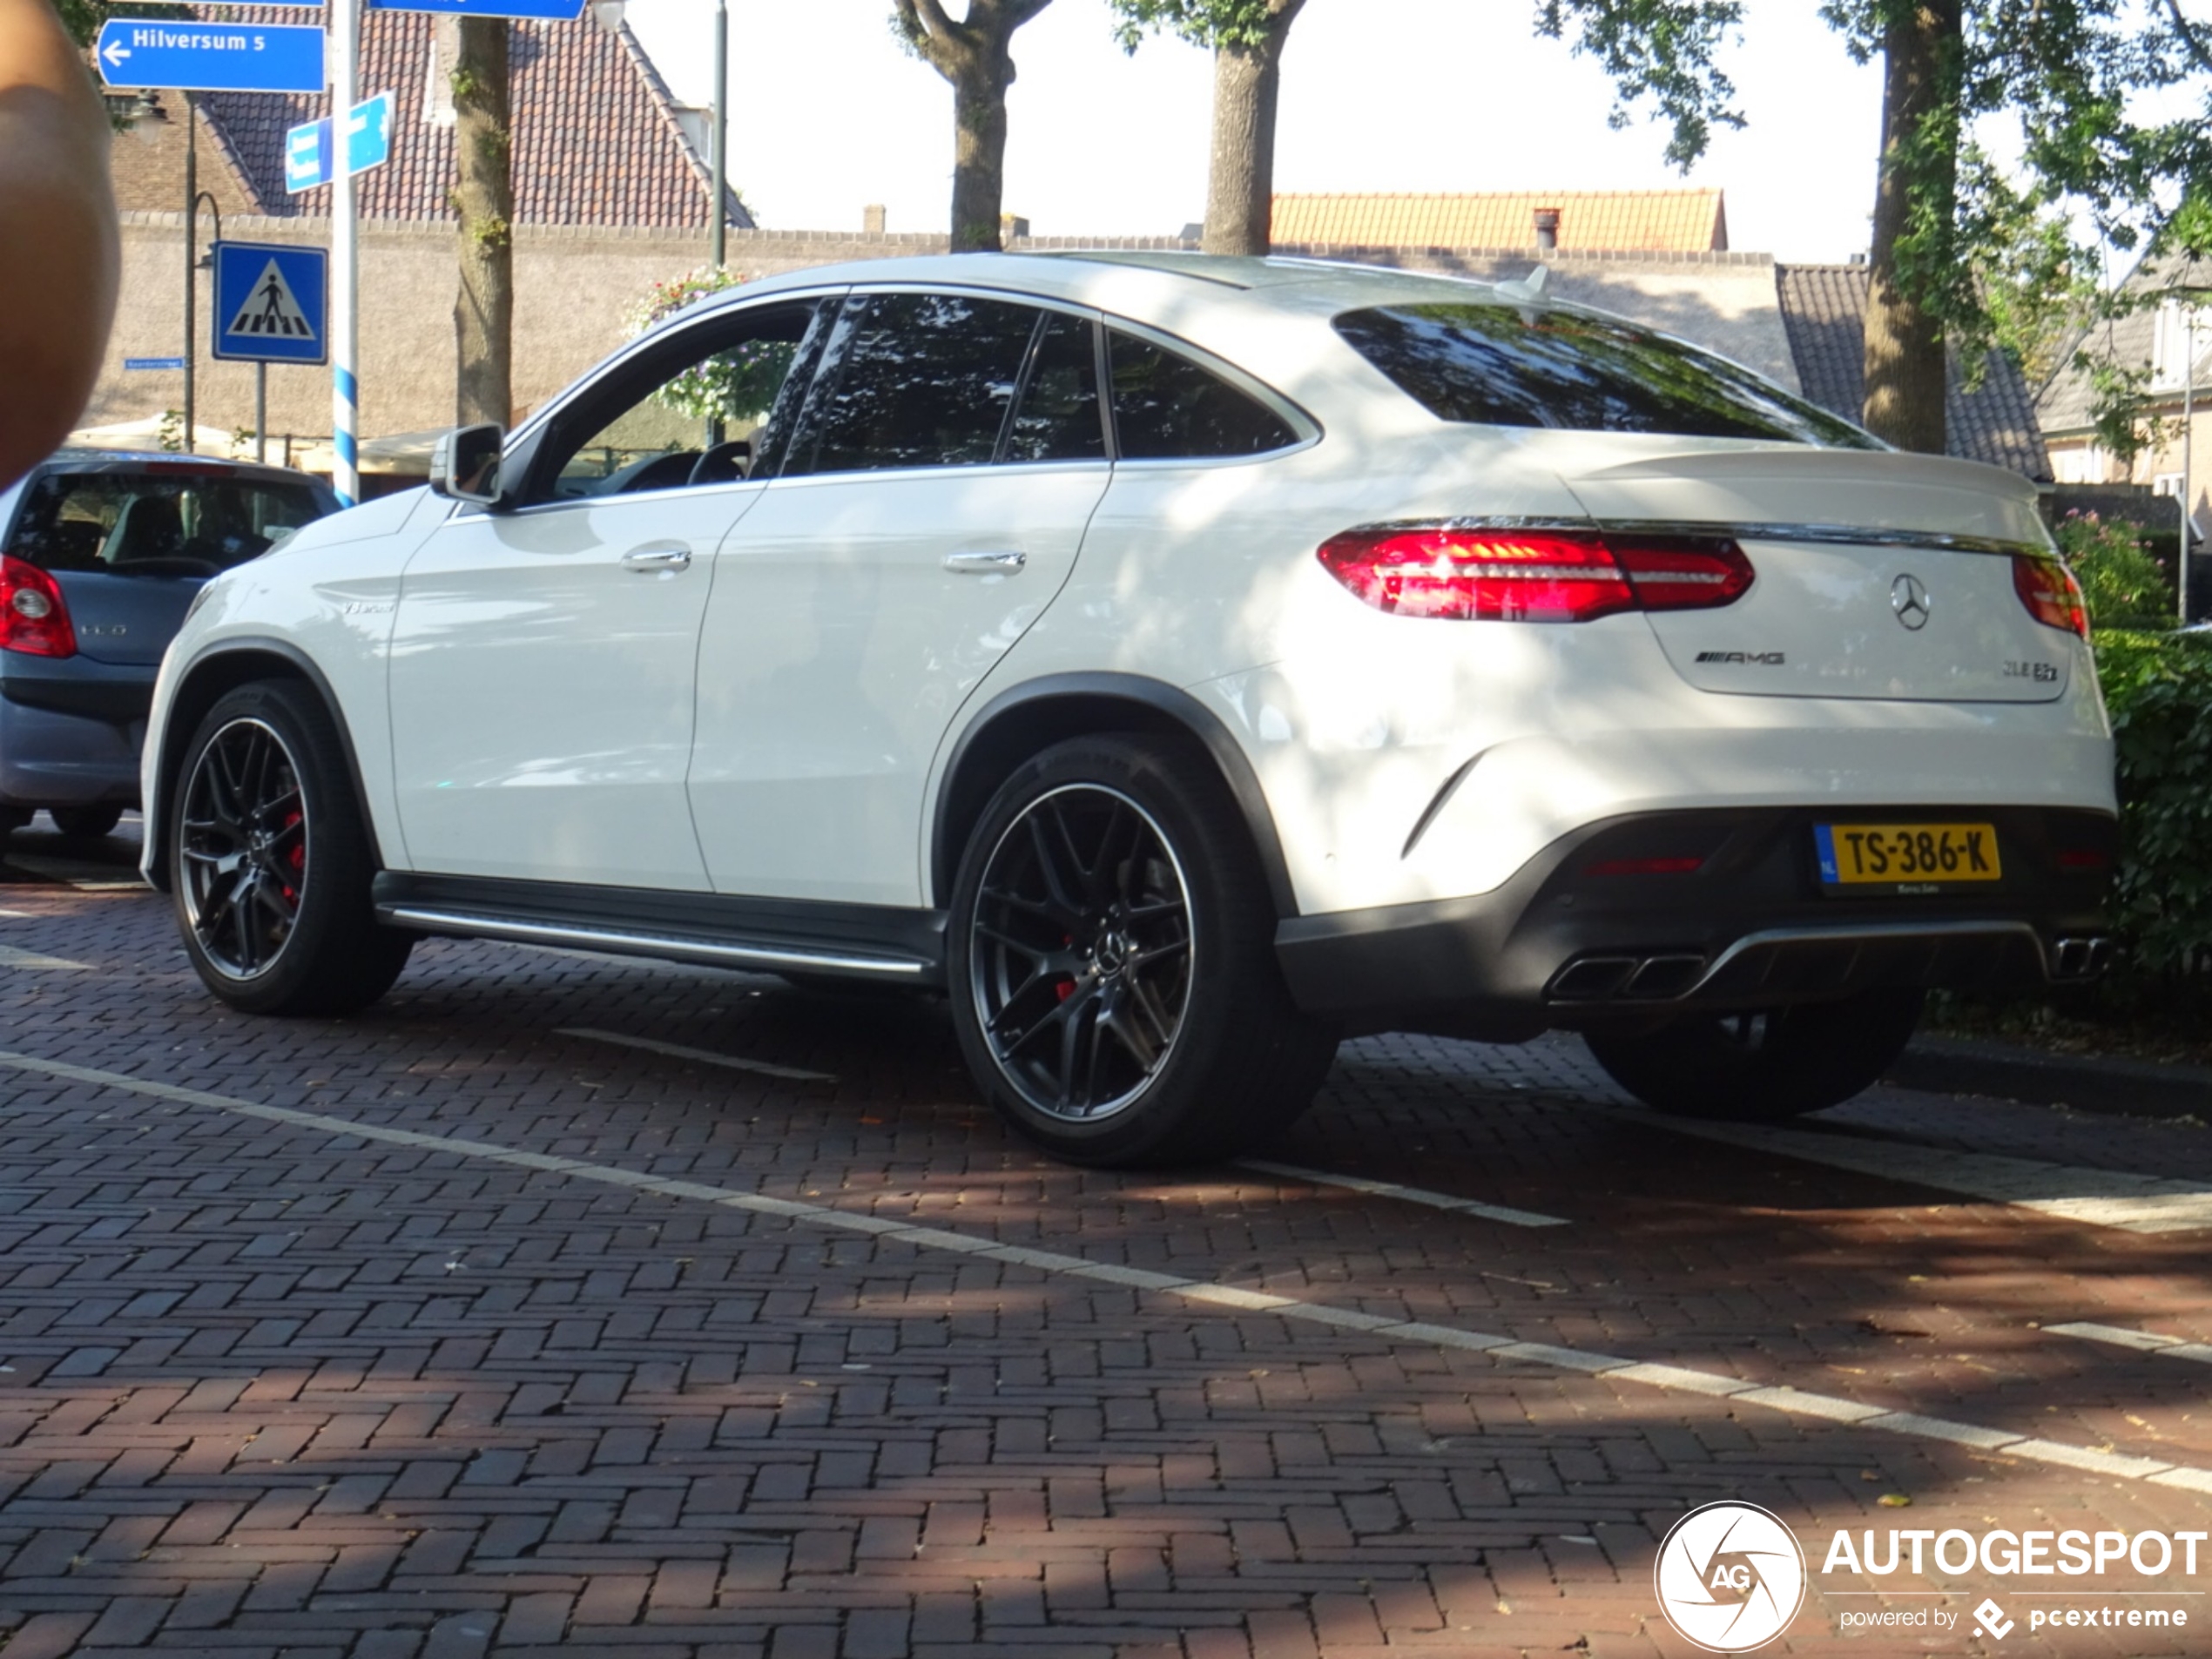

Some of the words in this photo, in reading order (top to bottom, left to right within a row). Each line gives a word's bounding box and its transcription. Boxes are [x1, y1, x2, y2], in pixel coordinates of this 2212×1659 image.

[133, 29, 246, 51] Hilversum
[253, 36, 266, 51] 5
[1724, 651, 1785, 665] AMG
[1844, 831, 1990, 874] TS-386-K
